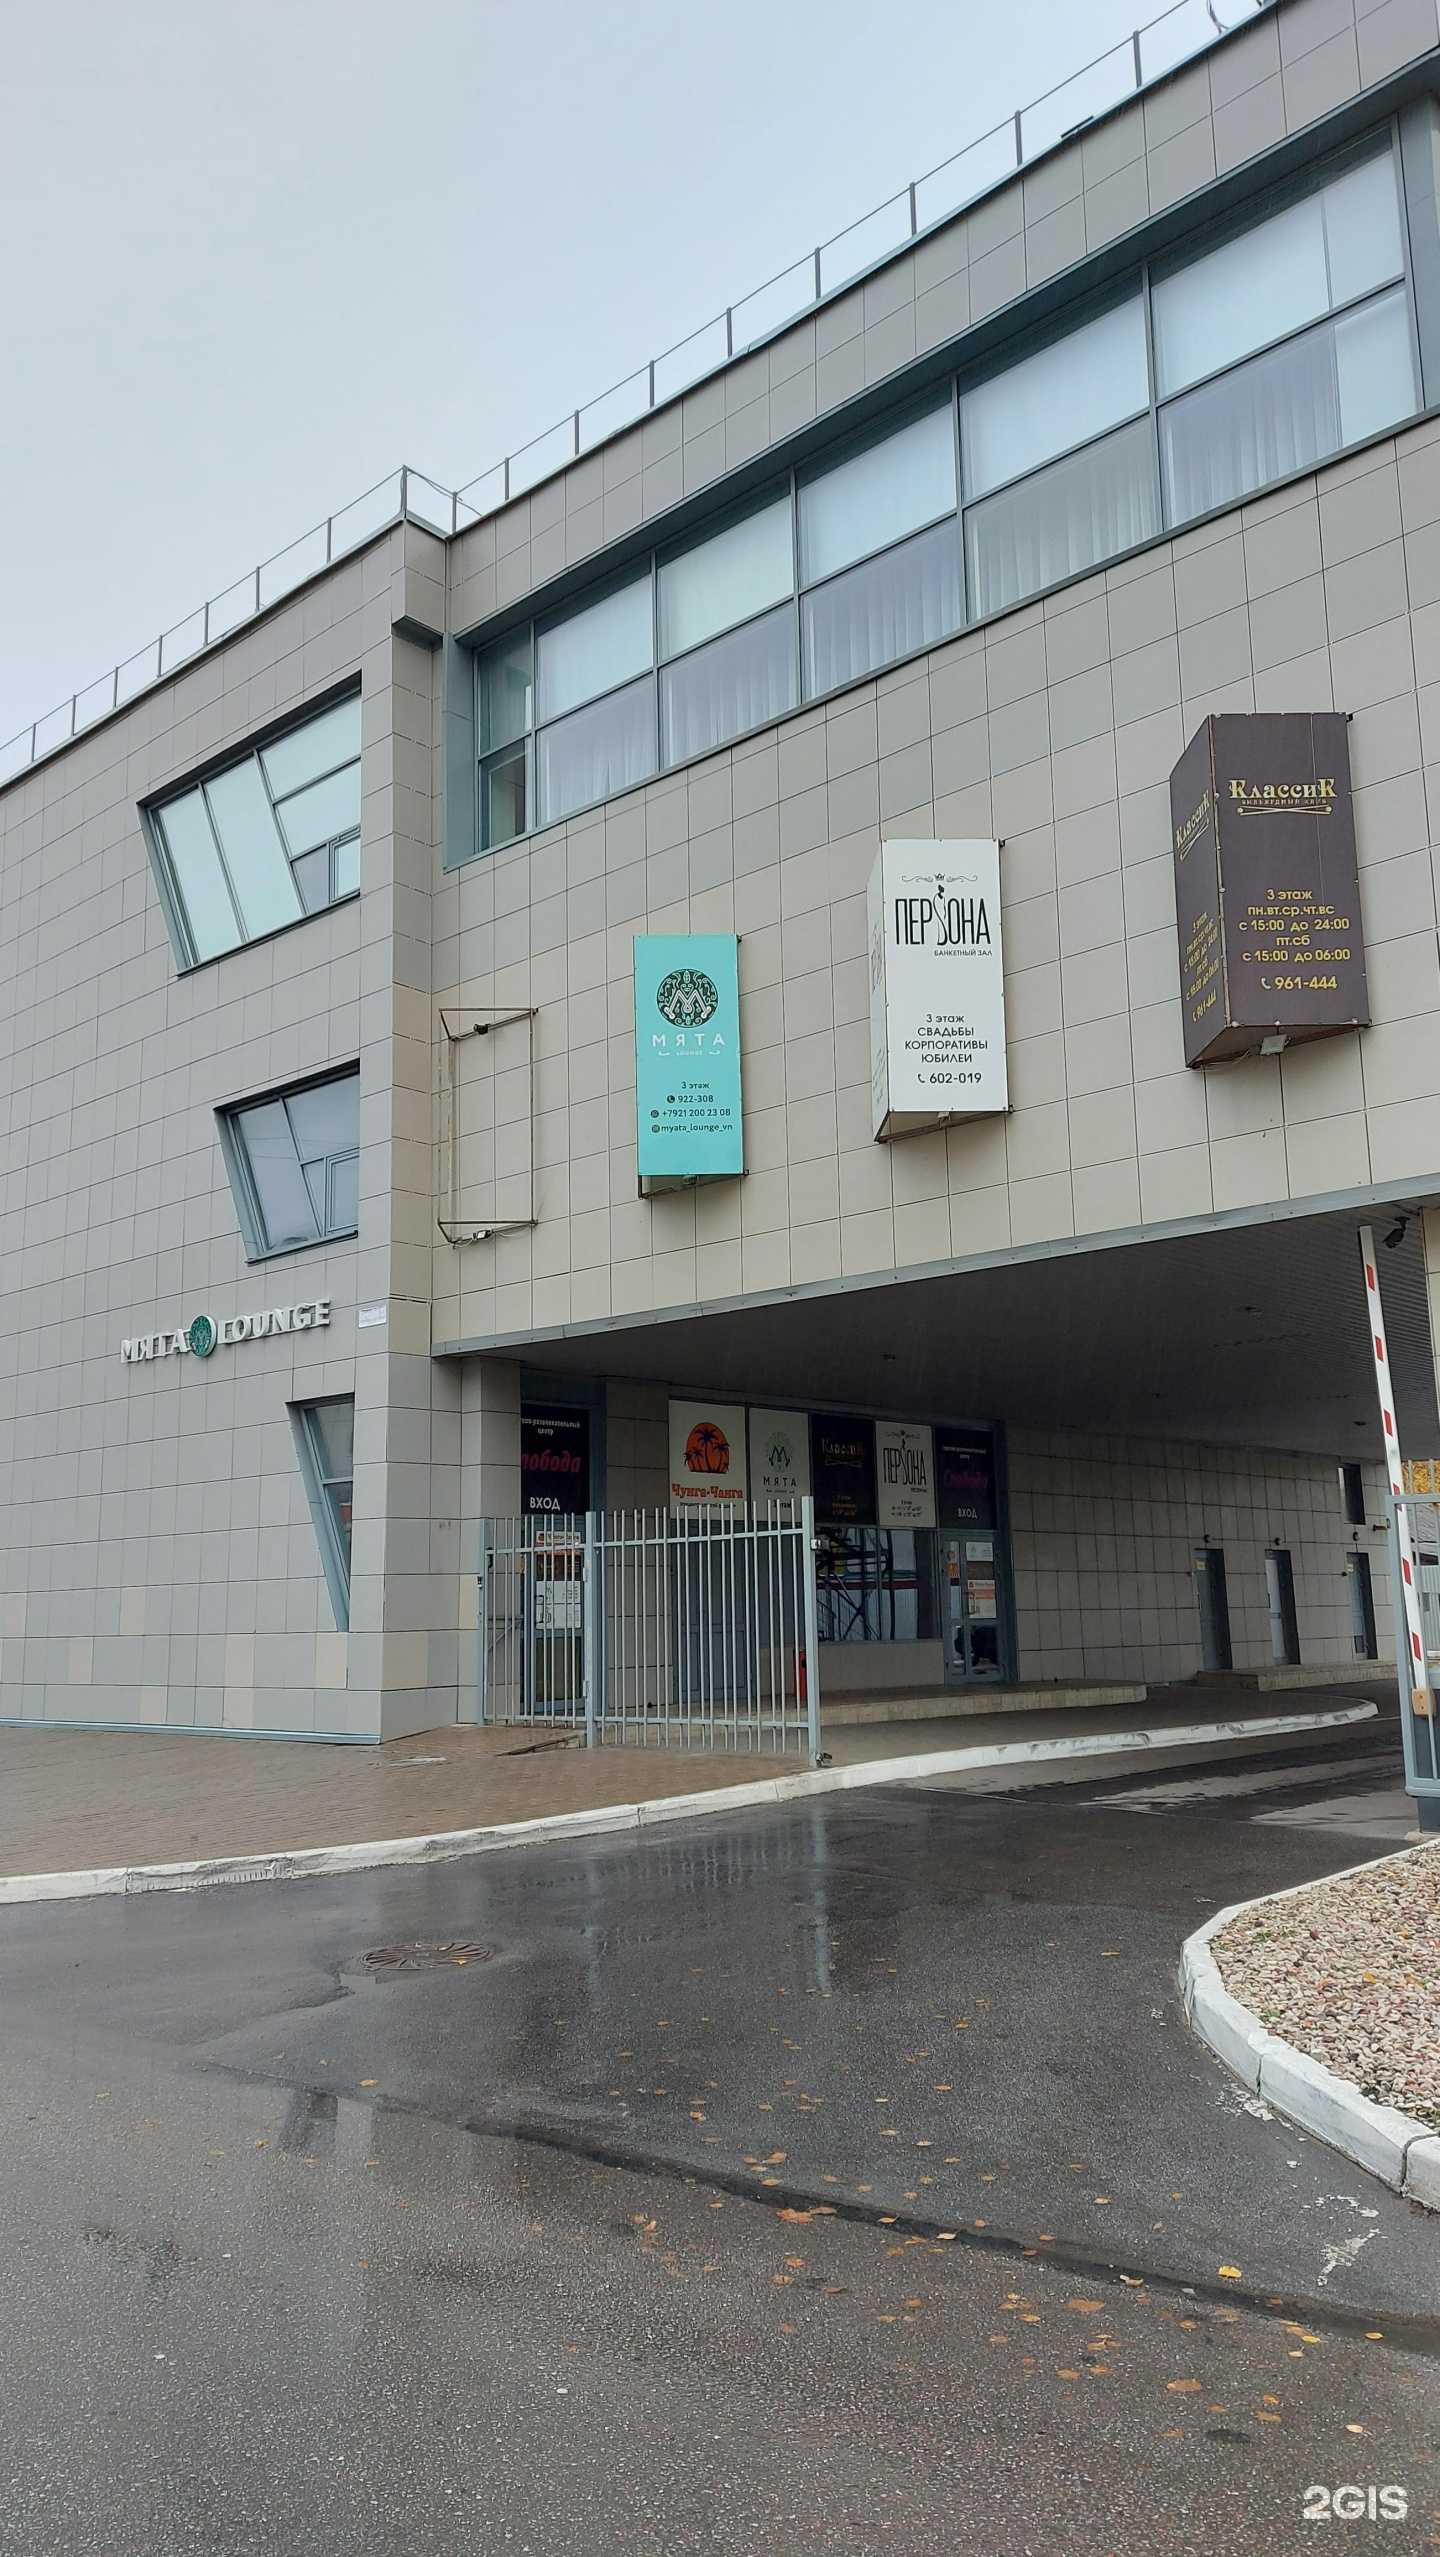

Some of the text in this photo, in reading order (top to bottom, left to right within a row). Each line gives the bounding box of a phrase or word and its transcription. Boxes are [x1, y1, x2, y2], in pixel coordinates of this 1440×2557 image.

[1267, 889, 1313, 900] 3 этаж
[1248, 905, 1335, 917] пн.вт.ср.чт.вс
[1239, 918, 1350, 932] с 15:00 до 24:00
[1276, 935, 1311, 946] пт.сб
[934, 948, 976, 956] БАНКЕТНЫЙ
[1242, 949, 1350, 963] с 15:00 до 06:00
[1274, 975, 1338, 989] 961-444
[926, 1014, 965, 1023] 3 этаж
[918, 1027, 974, 1037] СВАДЬБЫ
[652, 1033, 725, 1047] МЯТА
[905, 1040, 988, 1050] КОРПОРАТИВЫ
[930, 1072, 982, 1084] 602-019
[681, 1081, 687, 1089] 3
[678, 1094, 714, 1103] 922-308
[662, 1108, 731, 1117] +7921 200 23 08
[661, 1123, 733, 1133] myata_lounge_vn
[217, 1297, 331, 1344] LOUNGE
[763, 1475, 797, 1488] МЯТА
[671, 1482, 744, 1499] Чунга-Чанга
[529, 1496, 561, 1512] ВХОД
[957, 1507, 978, 1520] ВХОД
